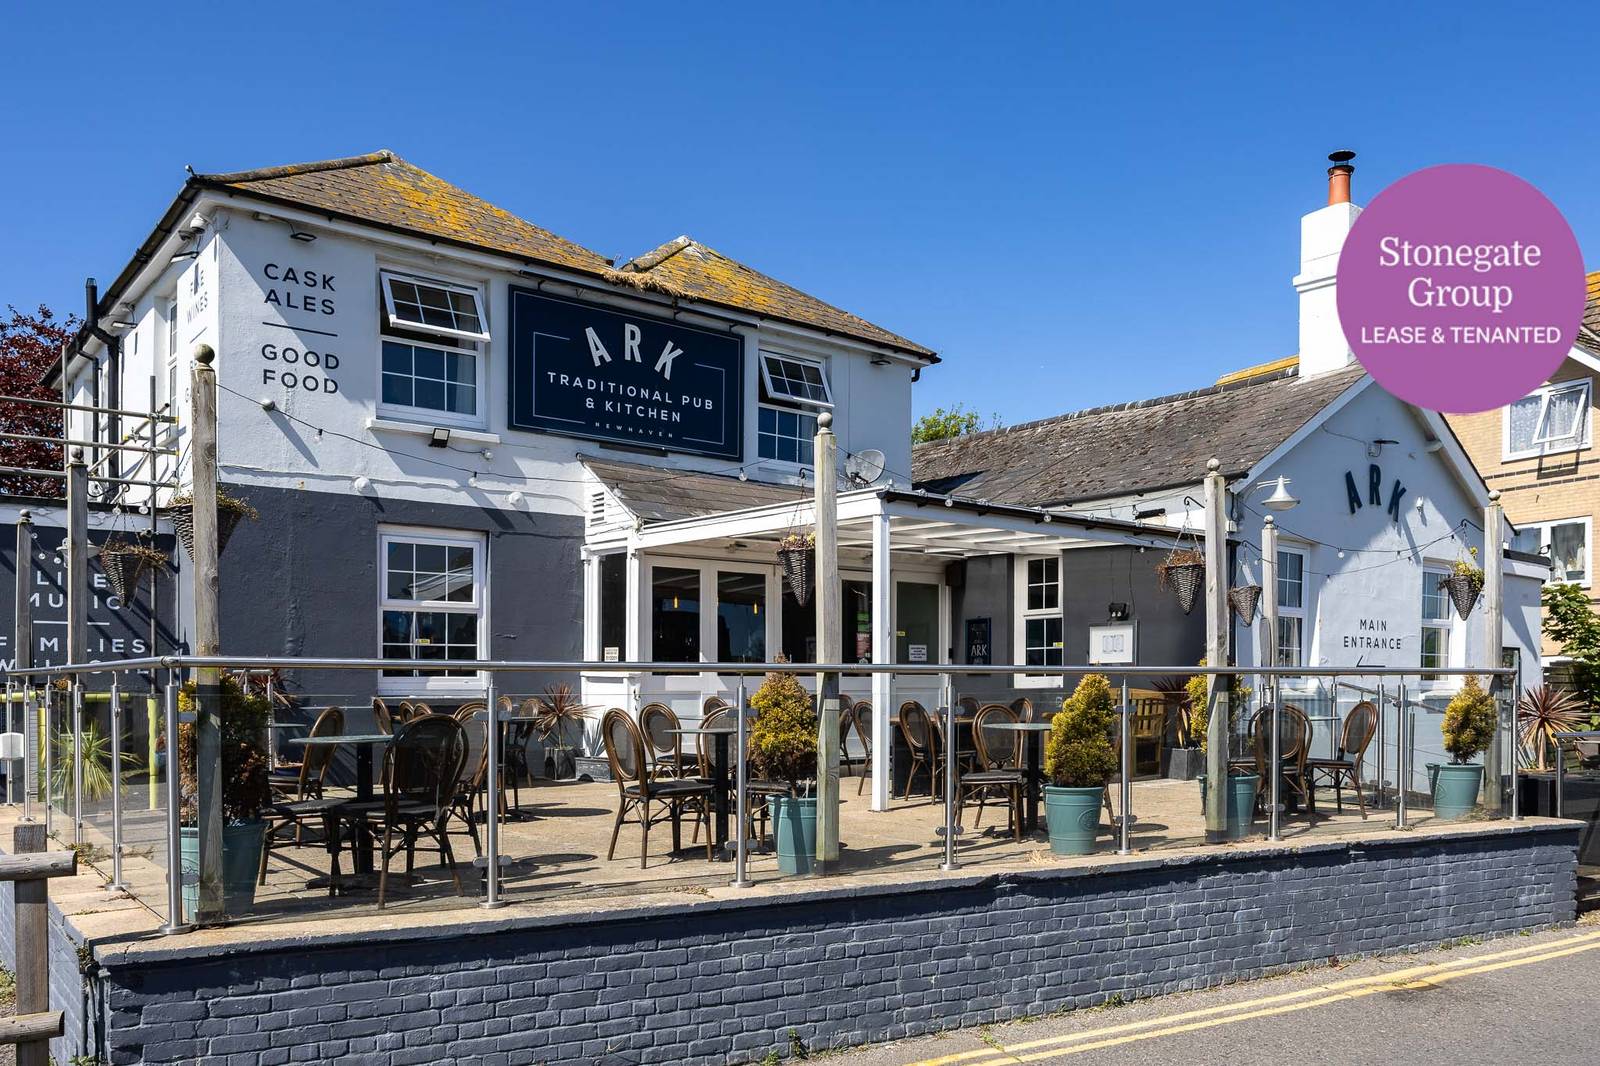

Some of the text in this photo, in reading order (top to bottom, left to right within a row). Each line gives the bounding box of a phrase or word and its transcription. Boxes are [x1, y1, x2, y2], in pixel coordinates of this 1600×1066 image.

[263, 263, 336, 292] CASK
[186, 291, 208, 325] WINES
[263, 289, 335, 316] ALES
[261, 343, 340, 370] GOOD
[585, 323, 684, 381] ARK
[262, 368, 339, 394] FOOD
[547, 371, 714, 410] TRADITIONAL PUB
[585, 397, 681, 423] & KITCHEN
[595, 422, 673, 438] NEWHAVEN
[1345, 463, 1407, 523] ARK
[36, 570, 107, 588] LIE
[29, 592, 121, 610] MUIC
[1359, 618, 1387, 631] MAIN
[971, 644, 988, 657] ARK
[1343, 636, 1402, 650] ENTRANCE
